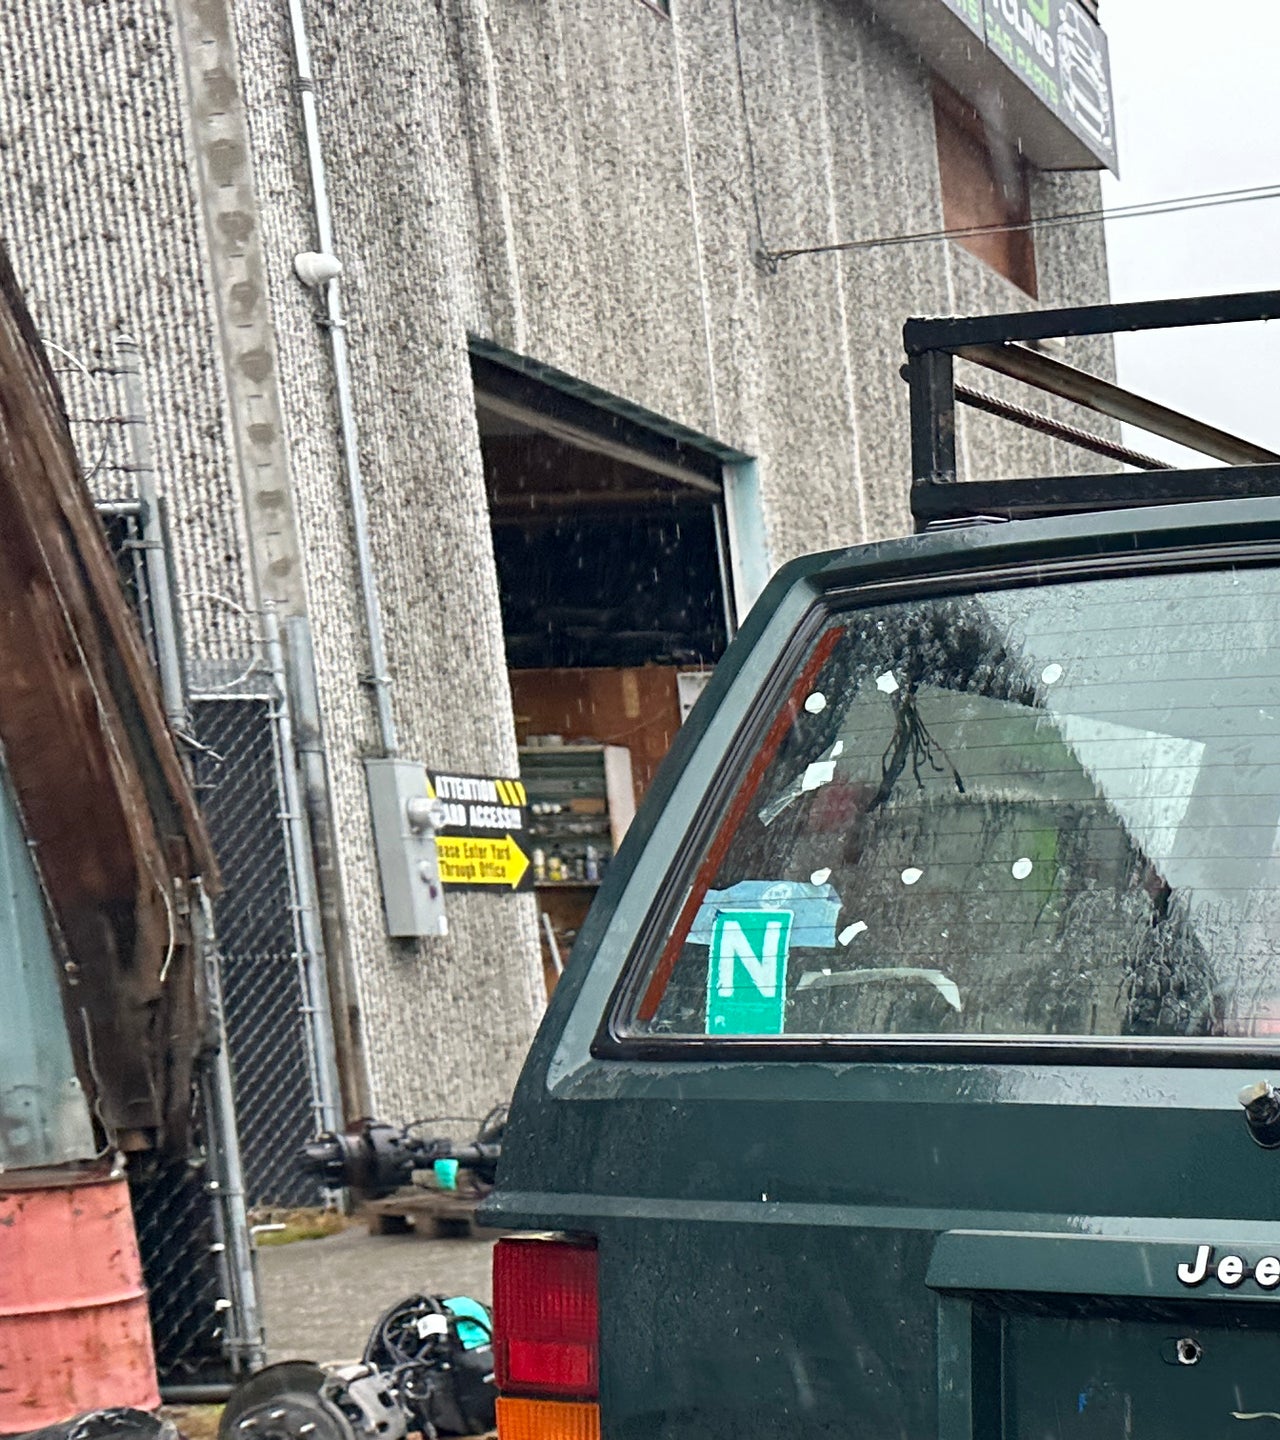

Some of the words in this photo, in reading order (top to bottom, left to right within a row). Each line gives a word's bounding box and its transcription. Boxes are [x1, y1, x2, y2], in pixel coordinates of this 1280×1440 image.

[435, 775, 498, 803] ATTENTION
[437, 845, 460, 859] ease
[463, 842, 488, 860] Enter
[490, 843, 511, 861] Yard
[439, 860, 476, 880] Through
[479, 861, 507, 879] Office
[717, 919, 783, 998] N
